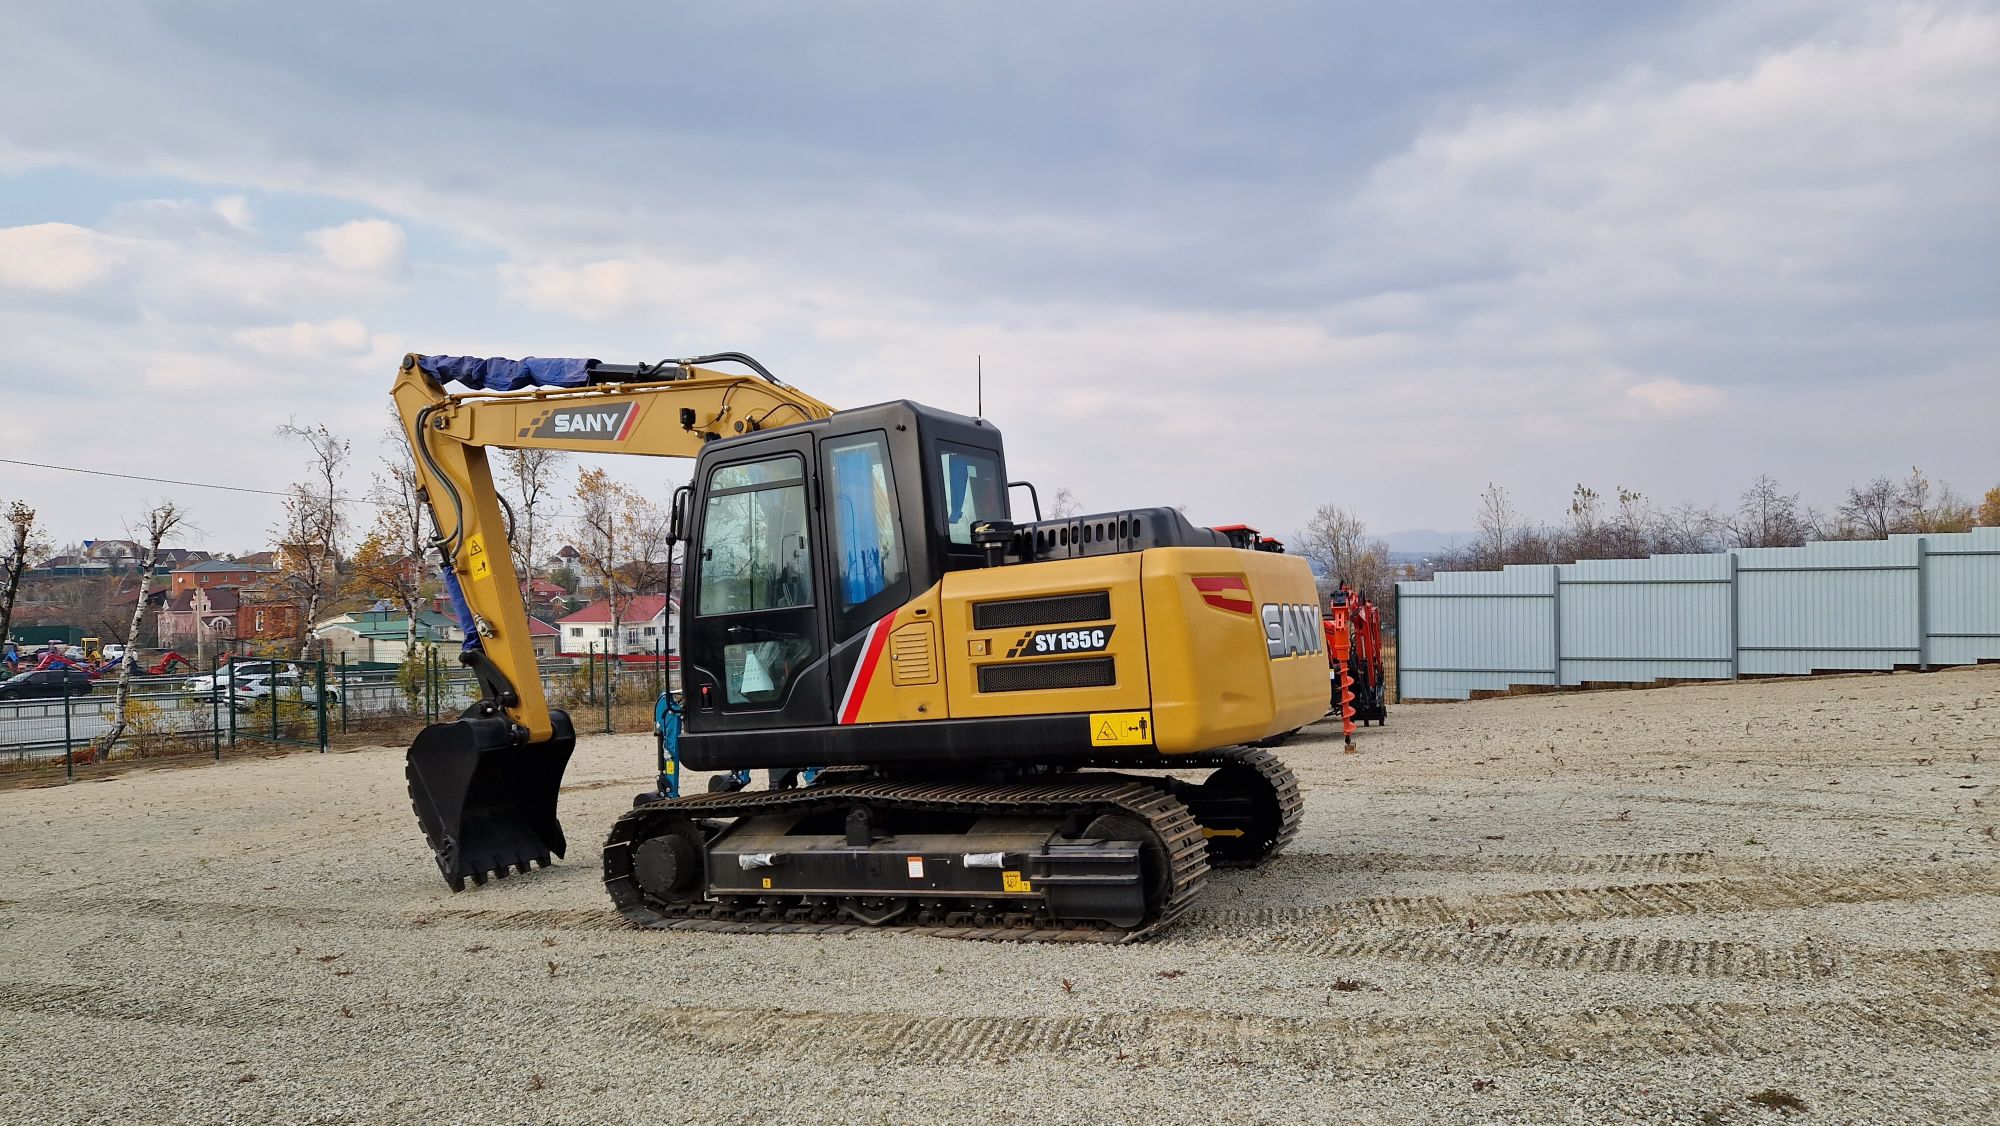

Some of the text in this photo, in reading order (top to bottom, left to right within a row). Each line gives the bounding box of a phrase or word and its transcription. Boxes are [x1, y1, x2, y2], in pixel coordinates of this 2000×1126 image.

[554, 413, 619, 433] SANY
[1035, 630, 1105, 652] SY135C
[1261, 603, 1322, 659] SANY
